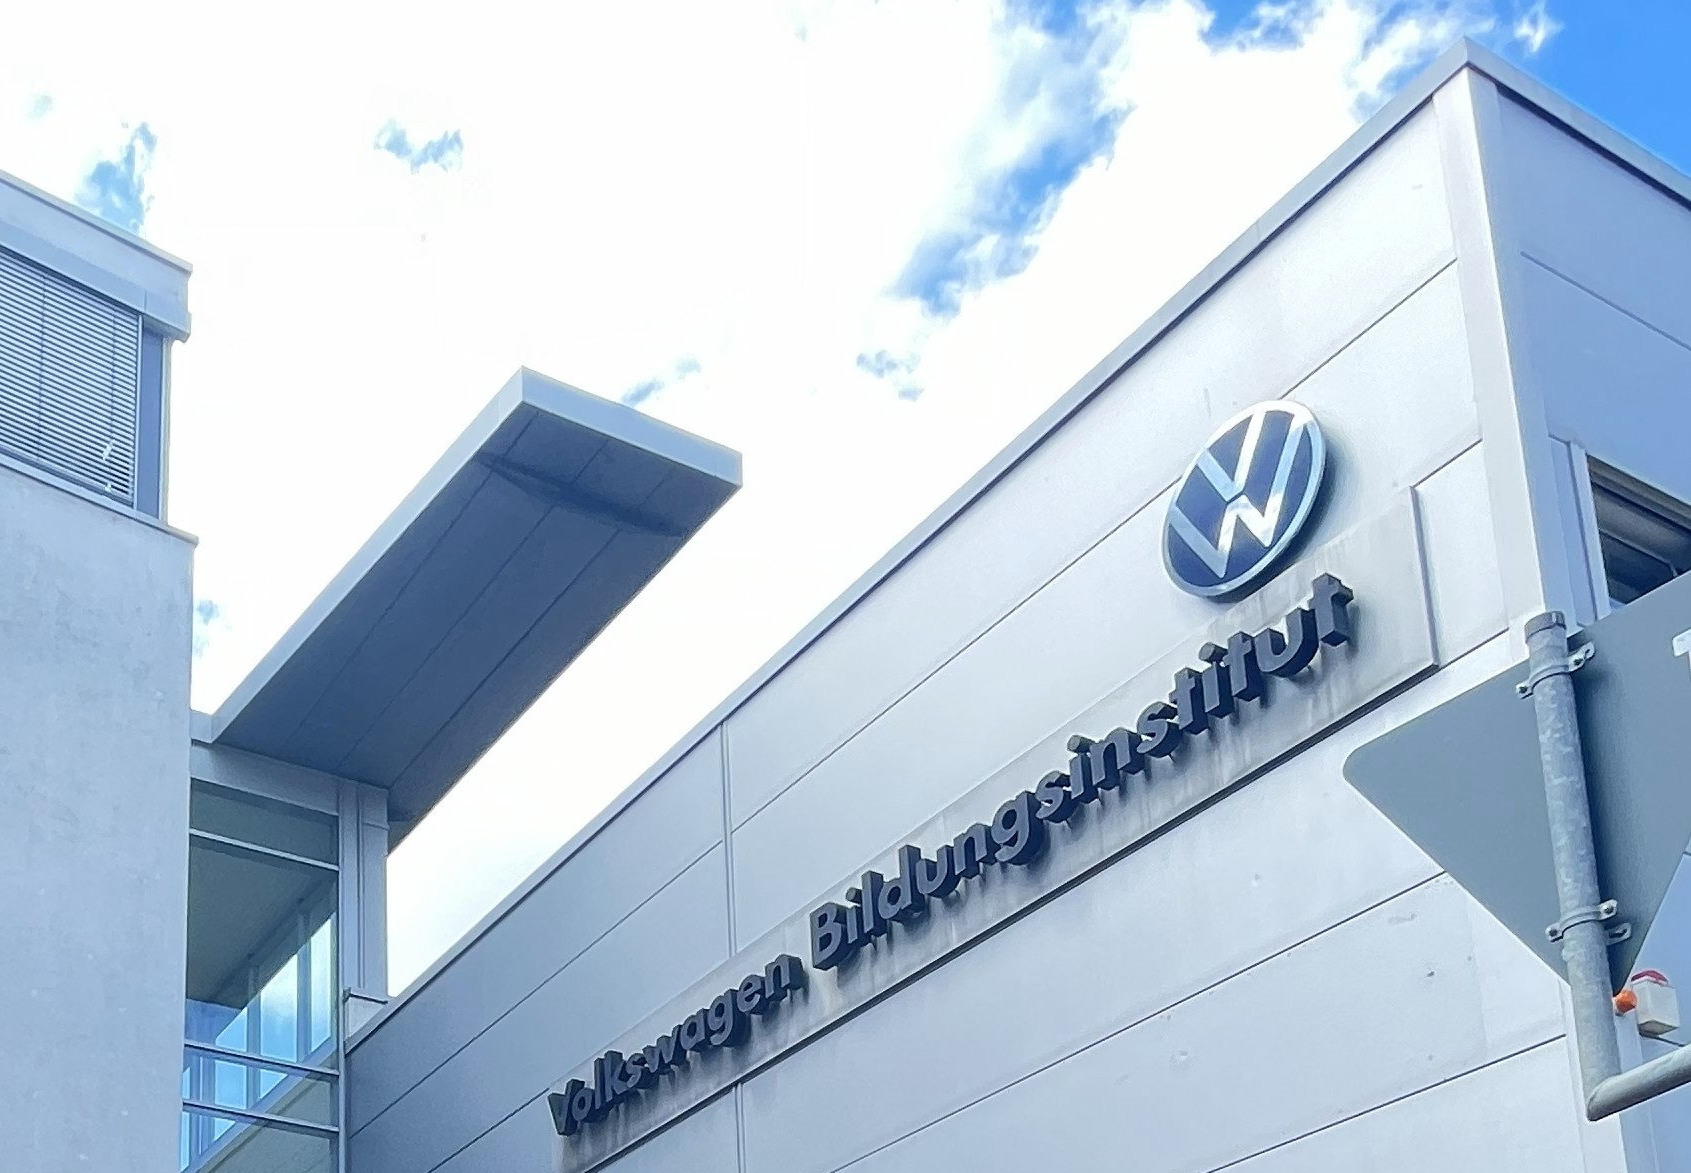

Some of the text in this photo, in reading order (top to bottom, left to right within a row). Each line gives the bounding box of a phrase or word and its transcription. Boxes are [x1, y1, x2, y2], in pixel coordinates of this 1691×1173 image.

[1164, 402, 1323, 596] VW
[547, 572, 1354, 1137] Volkswagen Bildungsinstitut
